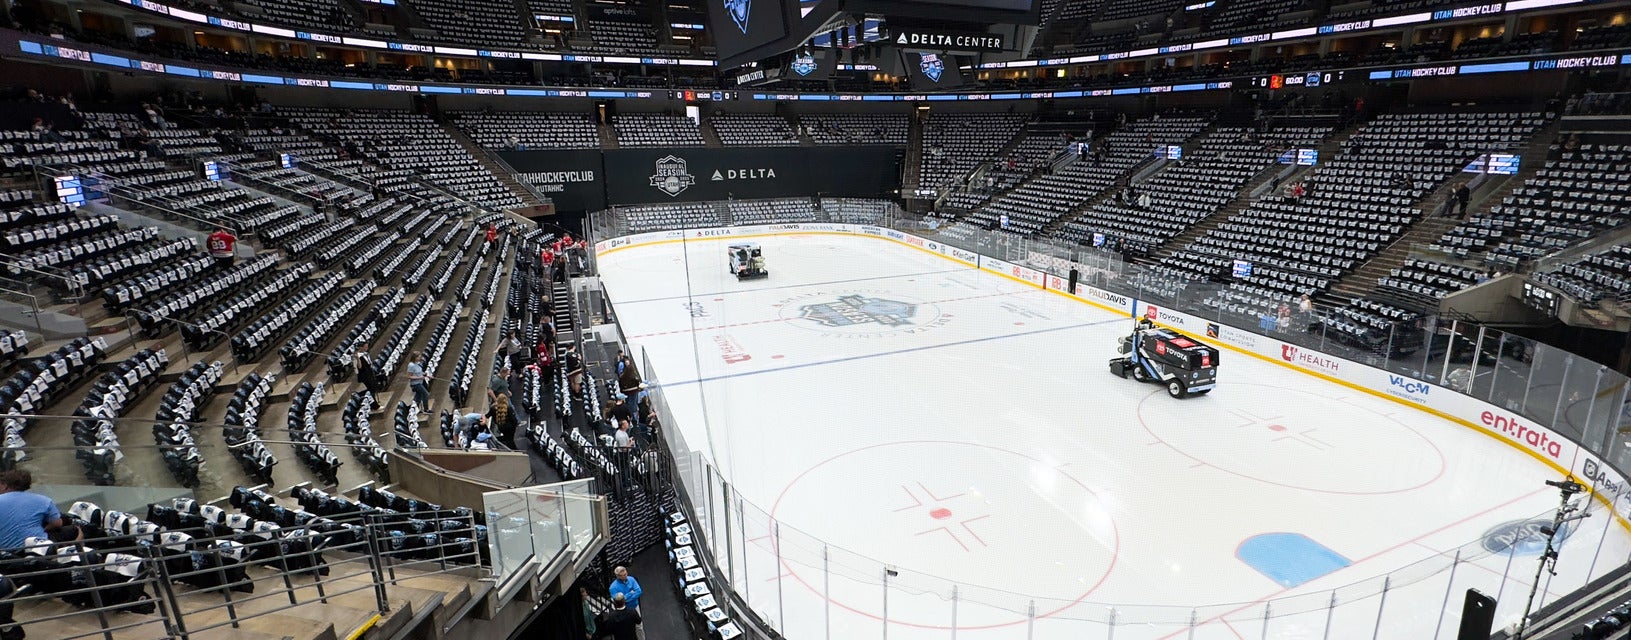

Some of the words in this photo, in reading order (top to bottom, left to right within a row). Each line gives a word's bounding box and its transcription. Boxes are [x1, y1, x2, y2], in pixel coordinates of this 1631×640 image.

[1433, 10, 1452, 19] UTAH
[1453, 6, 1482, 17] HOCKEY
[1481, 3, 1501, 14] CLUB
[208, 16, 221, 26] UTAH
[221, 18, 237, 29] HOCKEY
[237, 22, 250, 31] CLUB
[1318, 25, 1333, 34] UTAH
[1333, 23, 1354, 32] HOCKEY
[1355, 20, 1370, 30] CLUB
[297, 31, 311, 40] UTAH
[311, 33, 329, 42] HOCKEY
[329, 36, 341, 44] CLUB
[911, 33, 952, 46] DELTA
[956, 36, 1000, 48] CENTER
[1242, 35, 1258, 43] HOCKEY
[1258, 33, 1270, 41] CLUB
[389, 42, 402, 50] UTAH
[402, 44, 420, 52] HOCKEY
[78, 50, 91, 62] CLUB
[1533, 60, 1555, 69] UTAH
[1557, 57, 1591, 68] HOCKEY
[1592, 55, 1616, 66] CLUB
[212, 71, 229, 80] HOCKEY
[229, 73, 240, 81] CLUB
[1324, 74, 1331, 82] 0
[1394, 69, 1411, 78] UTAH
[1411, 67, 1438, 77] HOCKEY
[1437, 66, 1456, 75] CLUB
[297, 78, 316, 86] HOCKEY
[1261, 78, 1266, 86] 0
[1285, 76, 1303, 84] 60:00
[728, 168, 776, 179] DELTA
[1159, 311, 1184, 325] TOYOTA
[1165, 346, 1188, 361] TOYOTA
[1299, 352, 1339, 371] HEALTH
[1480, 410, 1561, 458] entrata
